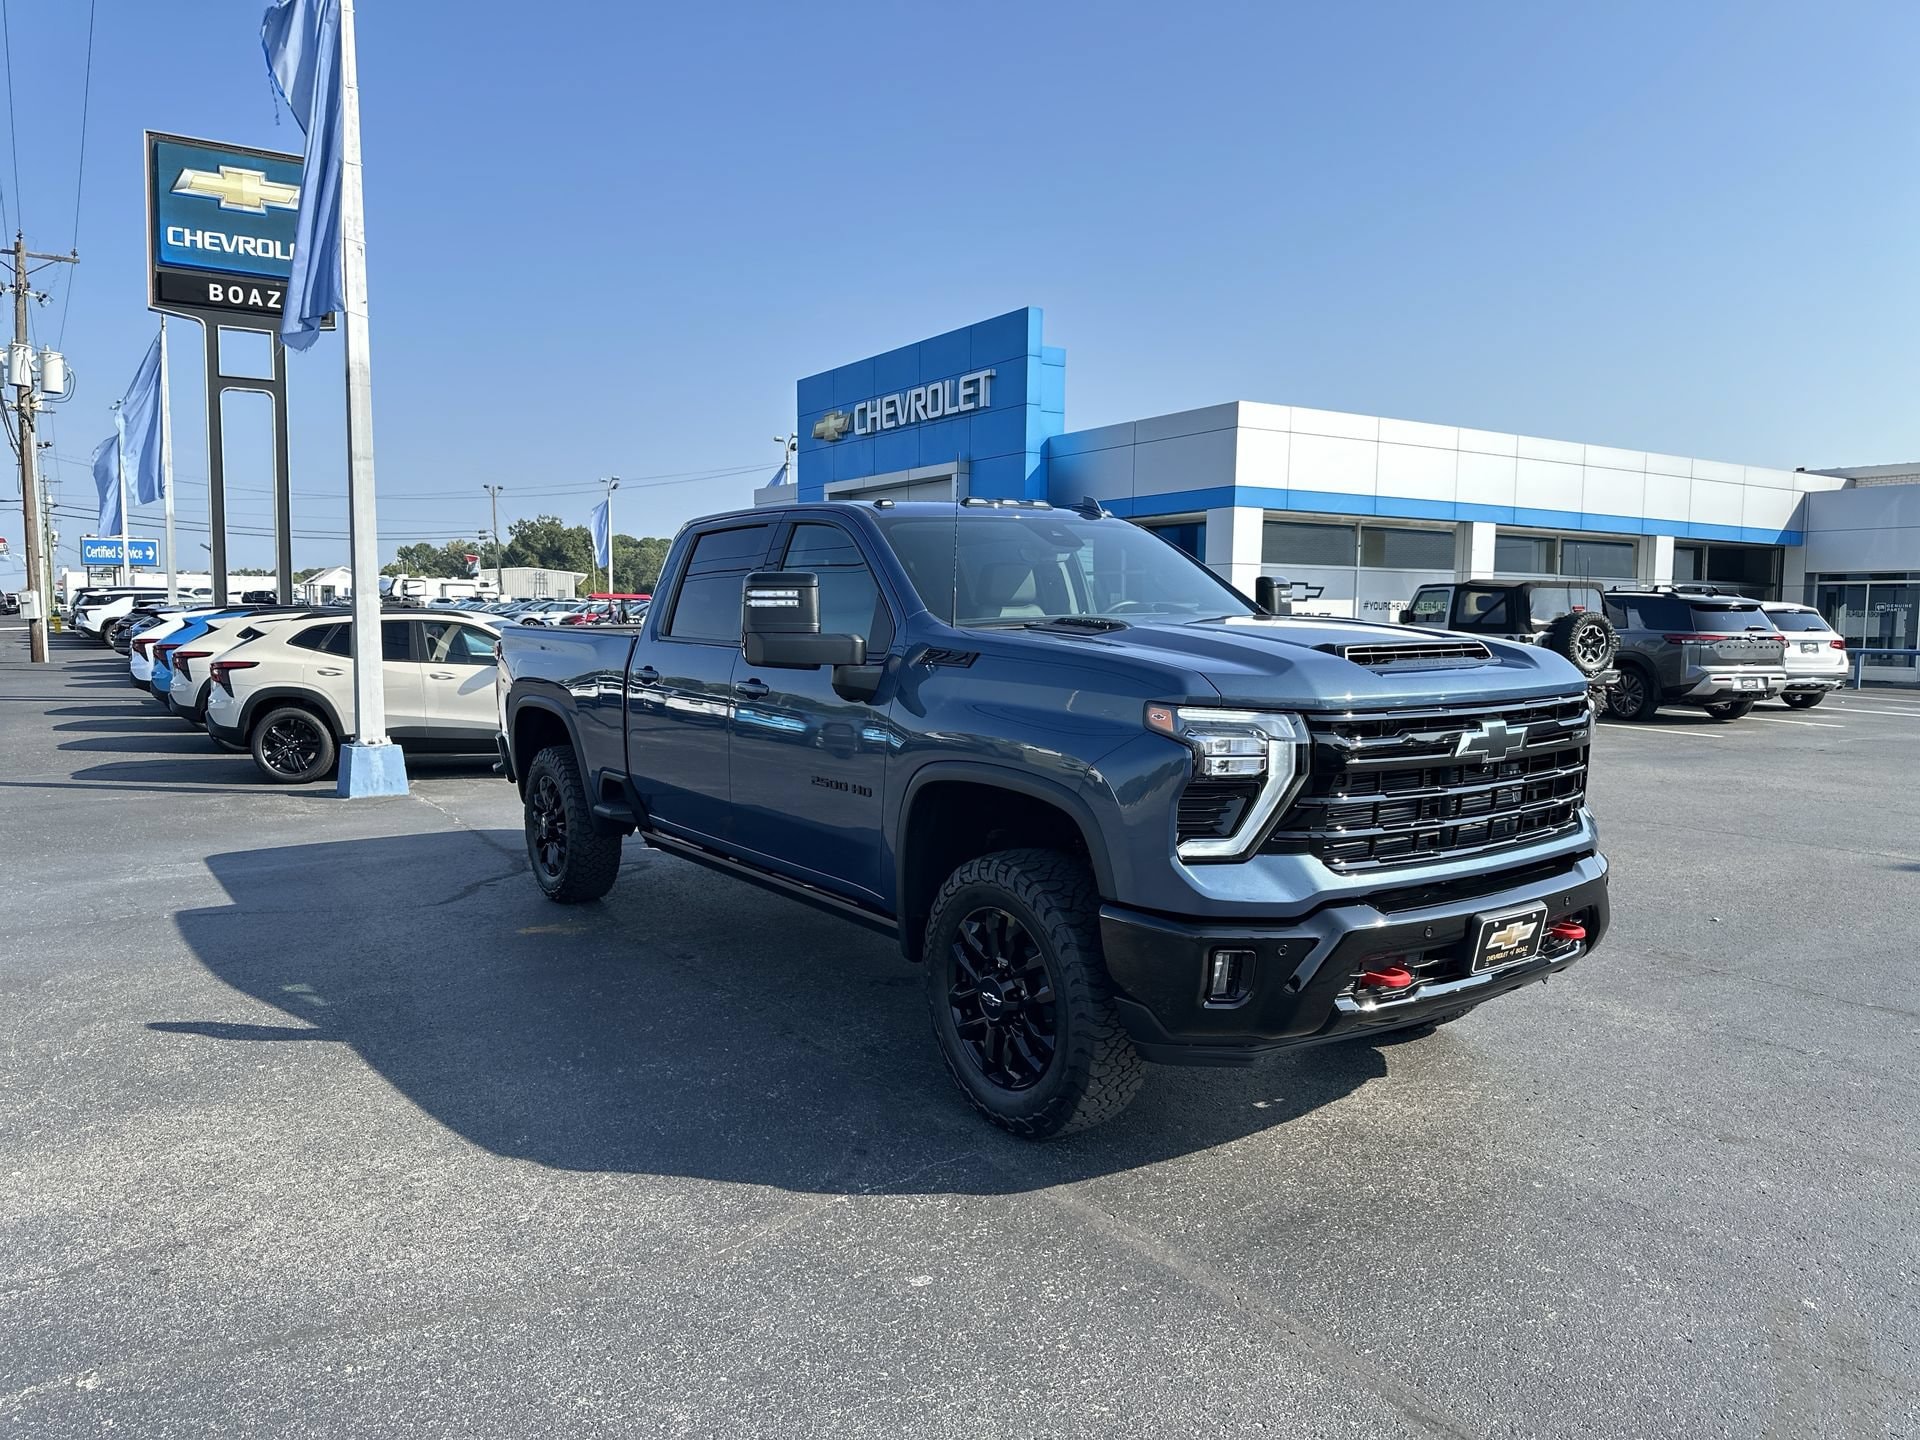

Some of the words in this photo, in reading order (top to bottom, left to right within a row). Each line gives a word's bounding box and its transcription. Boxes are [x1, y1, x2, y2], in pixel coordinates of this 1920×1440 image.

[167, 226, 295, 260] CHEVROL
[208, 283, 281, 308] BOAZ
[854, 368, 996, 435] CHEVROLET
[86, 545, 116, 559] Certified
[118, 546, 143, 559] Svice
[811, 776, 848, 791] 2500
[852, 784, 873, 798] HD
